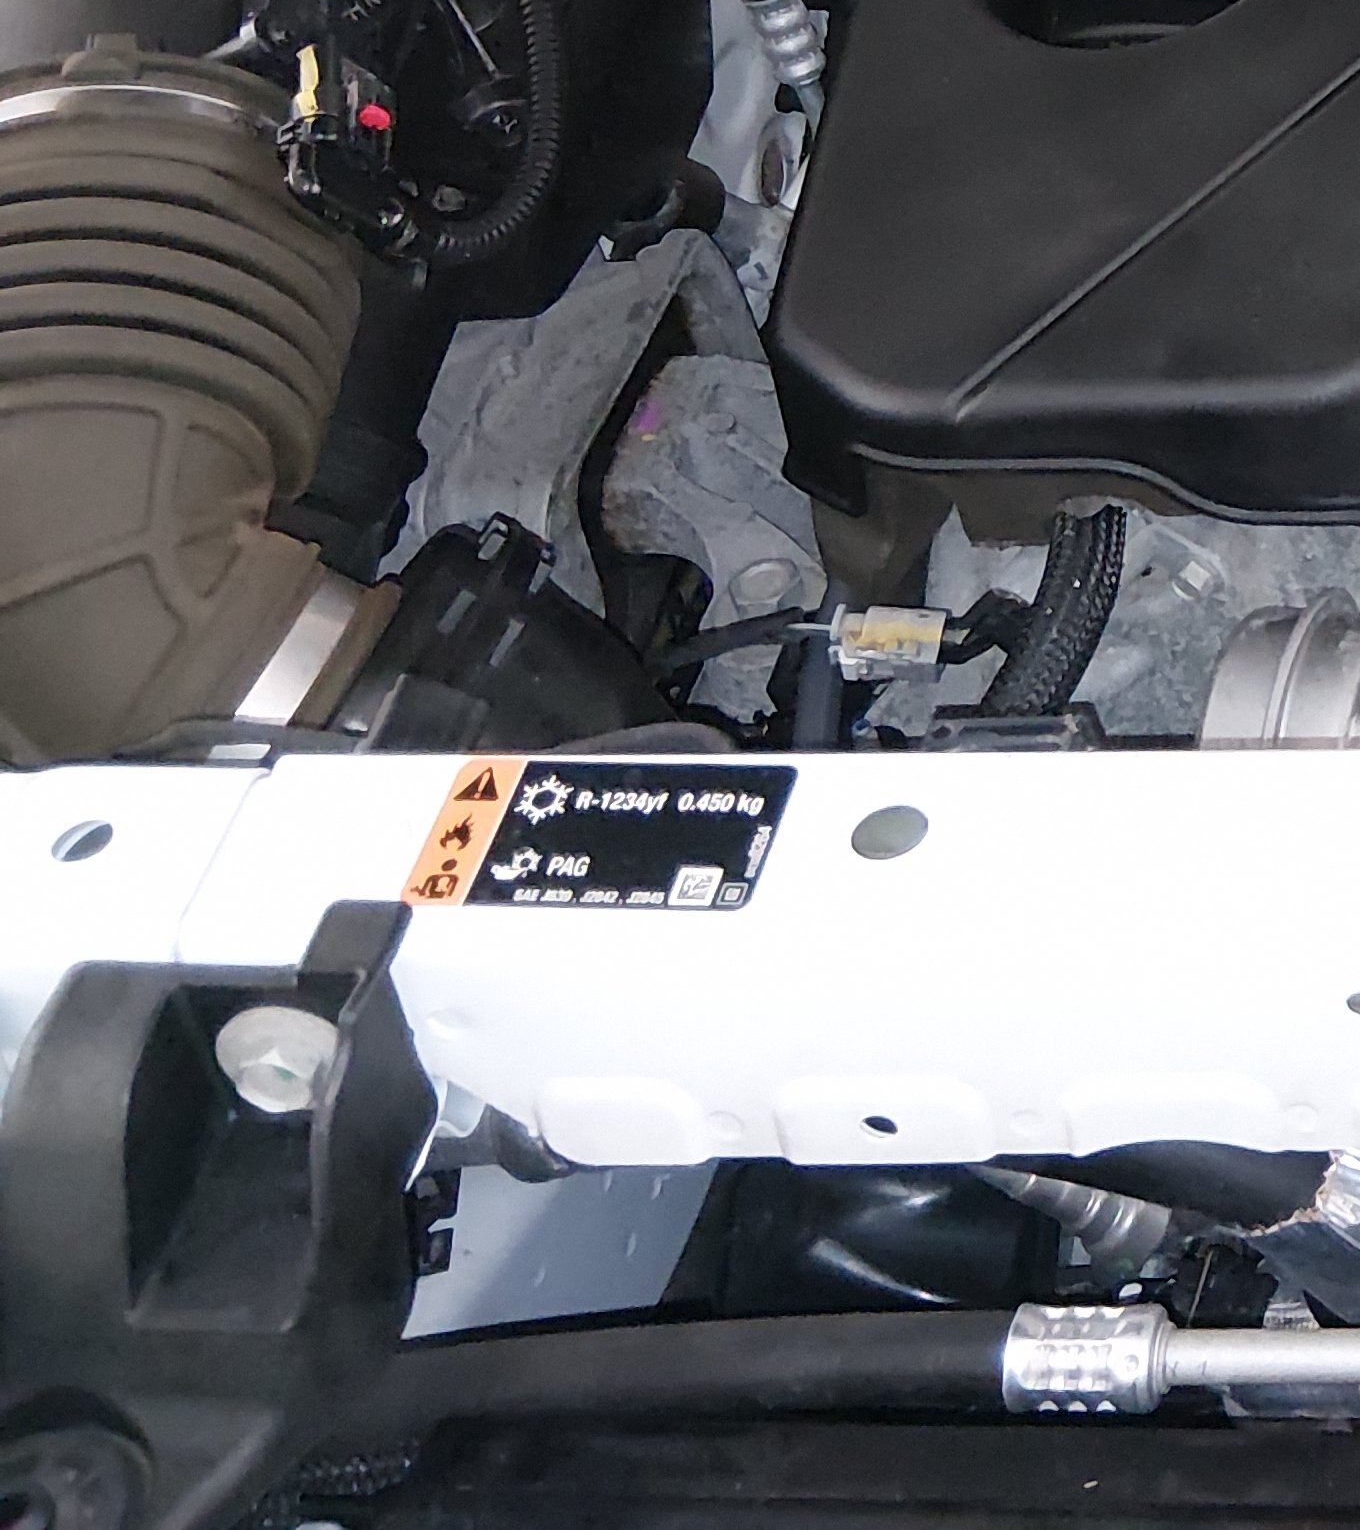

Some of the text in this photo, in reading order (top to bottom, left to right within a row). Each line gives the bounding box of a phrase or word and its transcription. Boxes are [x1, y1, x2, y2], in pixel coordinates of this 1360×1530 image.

[574, 791, 766, 817] R-1234yf 0.450 kg
[545, 855, 592, 878] PAG
